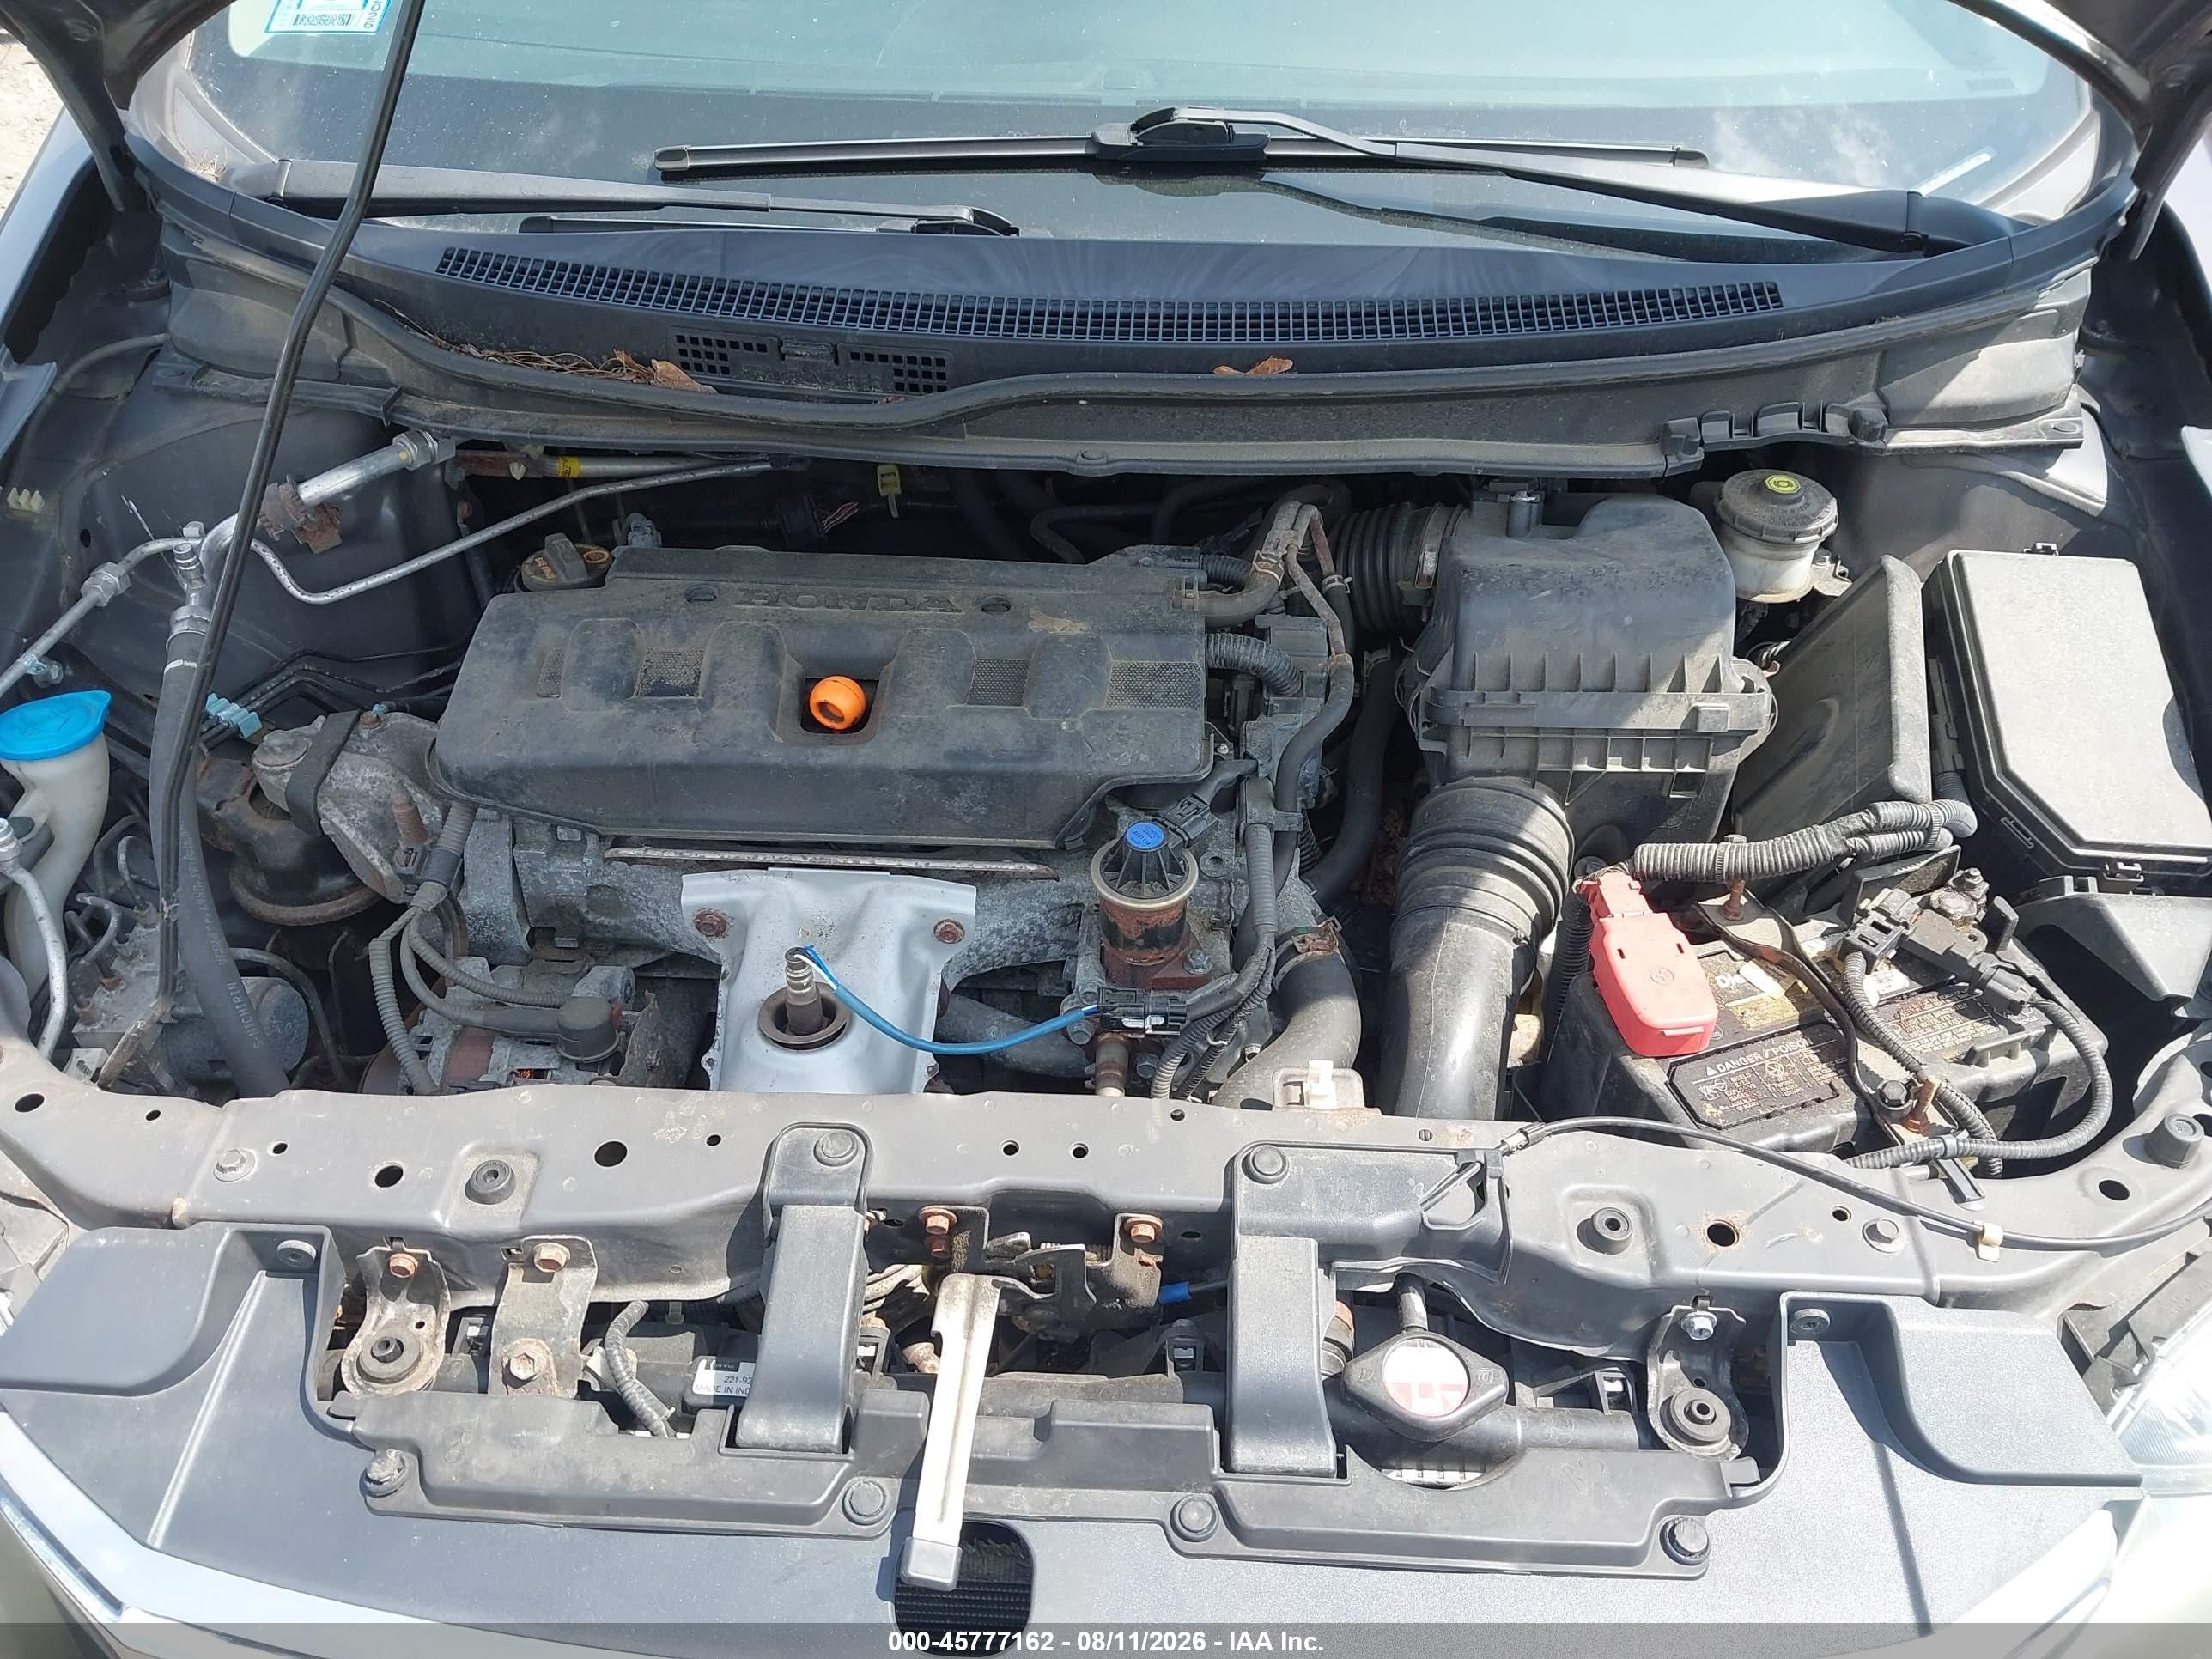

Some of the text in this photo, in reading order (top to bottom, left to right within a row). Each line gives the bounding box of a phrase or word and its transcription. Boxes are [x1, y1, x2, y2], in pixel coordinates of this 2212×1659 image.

[736, 587, 964, 613] HONDA
[1716, 1054, 1761, 1071] DANGER
[1771, 1038, 1814, 1055] POISON
